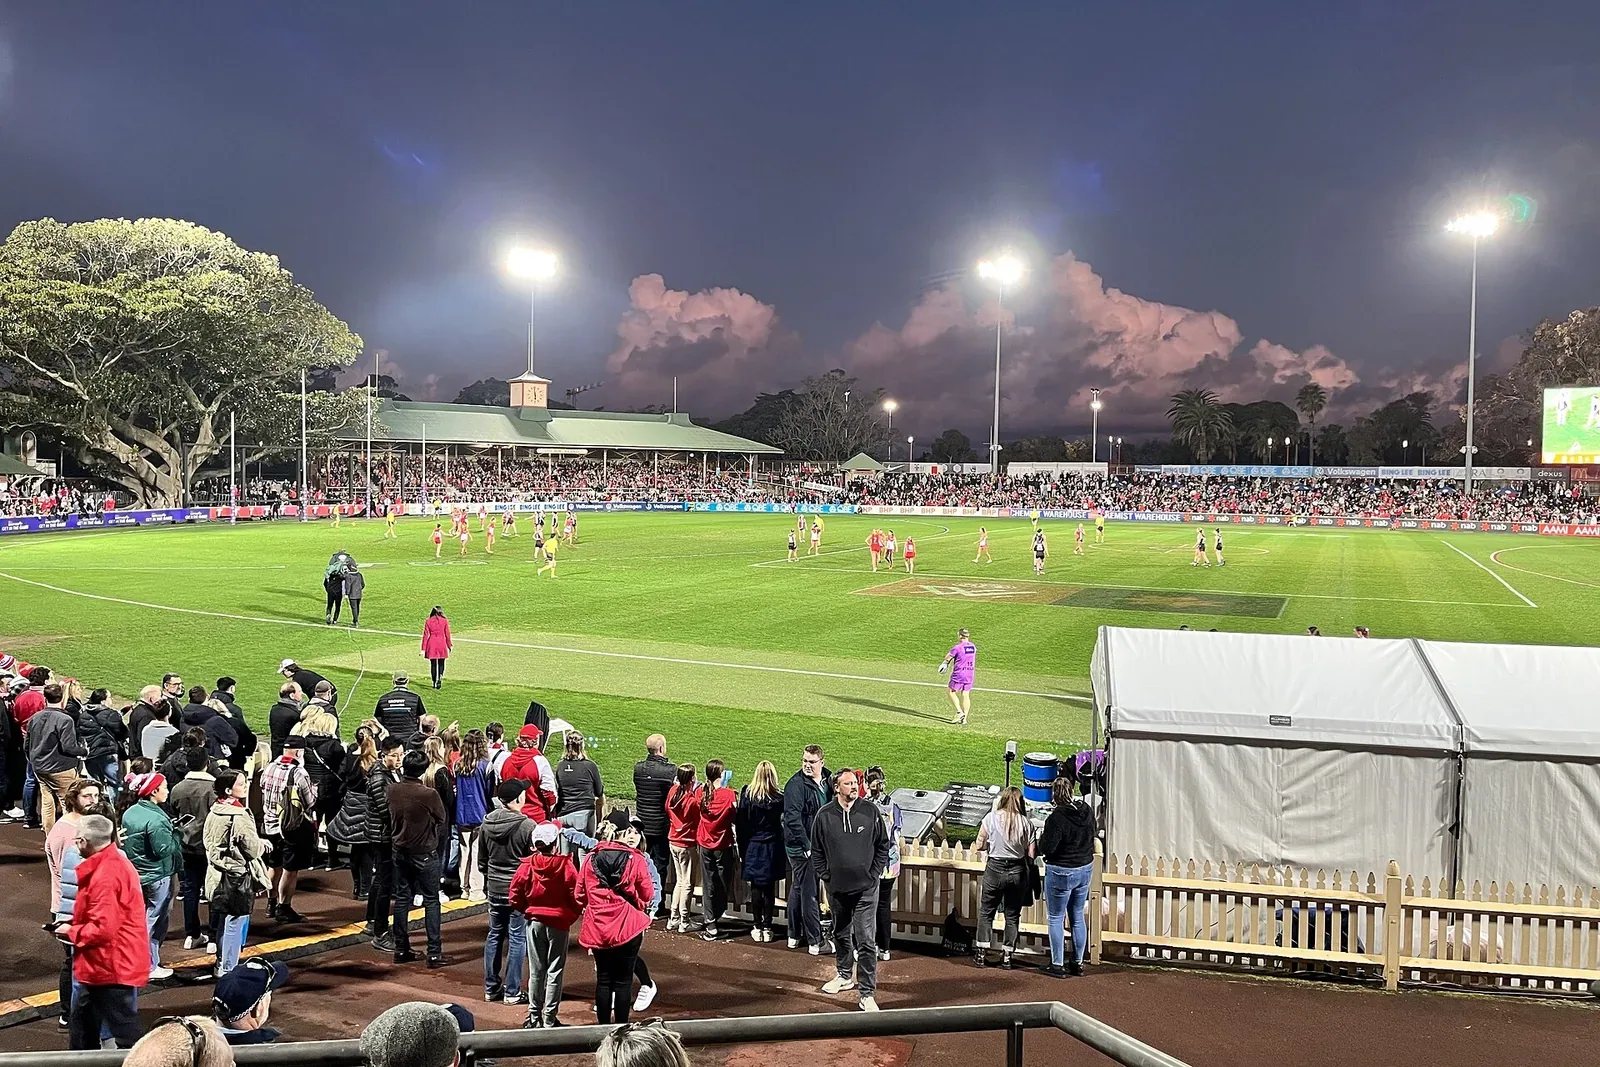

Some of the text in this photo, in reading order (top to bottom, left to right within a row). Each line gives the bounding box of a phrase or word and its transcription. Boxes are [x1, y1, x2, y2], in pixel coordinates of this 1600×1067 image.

[1327, 468, 1376, 477] Volkswagen
[1044, 510, 1087, 518] WAREHOUSE
[1134, 512, 1180, 520] WAREHOUSE
[1374, 518, 1388, 526] nab
[1431, 520, 1446, 528] nab
[1461, 521, 1476, 529] nab
[1491, 522, 1507, 530] nab
[1522, 523, 1538, 531] nab
[1542, 525, 1568, 534] AAMI
[1574, 526, 1600, 535] AAMI
